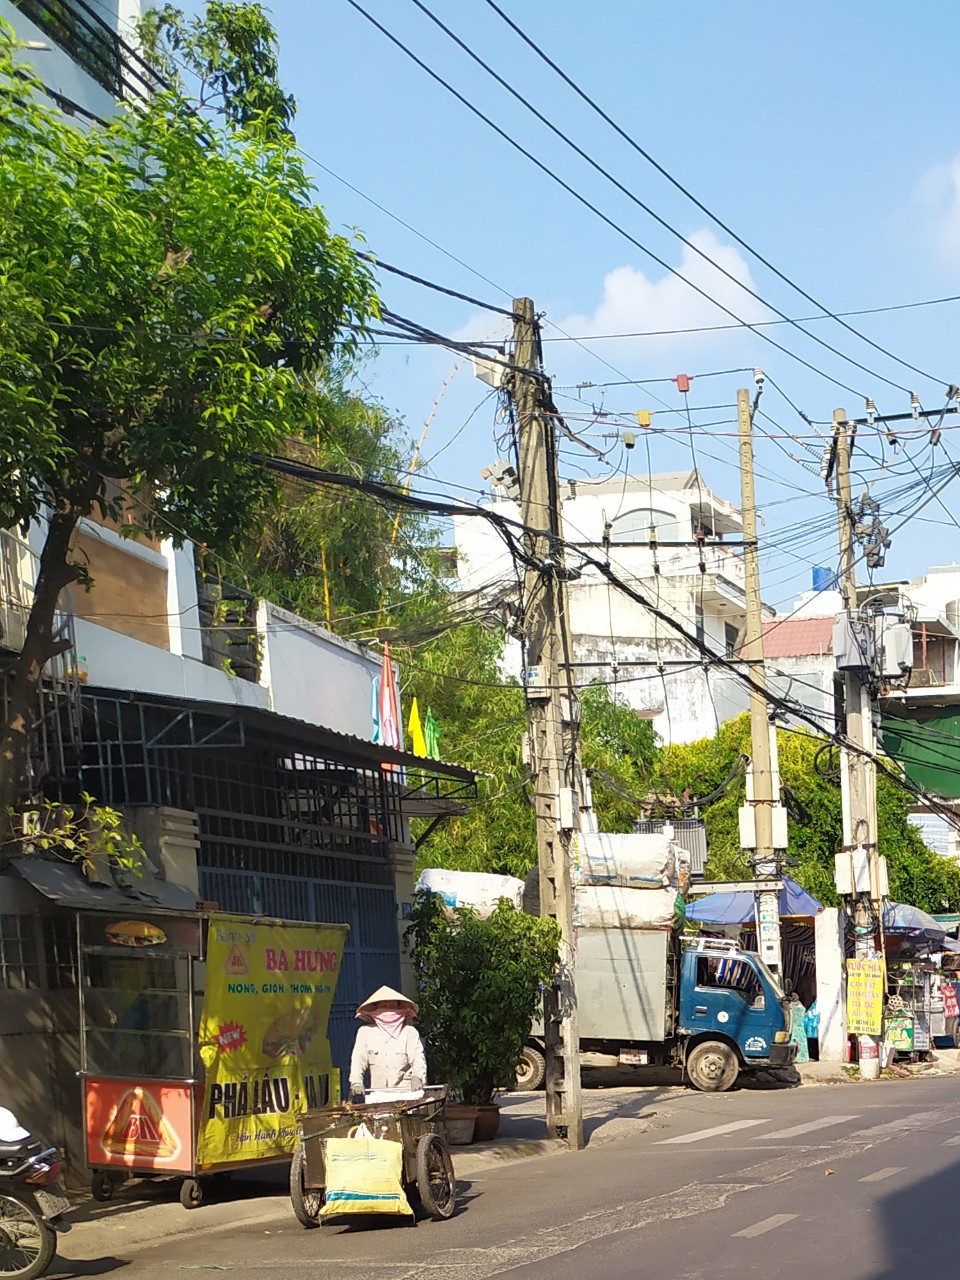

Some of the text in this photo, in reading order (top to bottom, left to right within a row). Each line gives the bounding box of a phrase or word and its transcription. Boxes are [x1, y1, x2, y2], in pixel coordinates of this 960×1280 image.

[265, 947, 290, 972] BA
[218, 1029, 241, 1045] NEW
[208, 1074, 249, 1120] PHÁ
